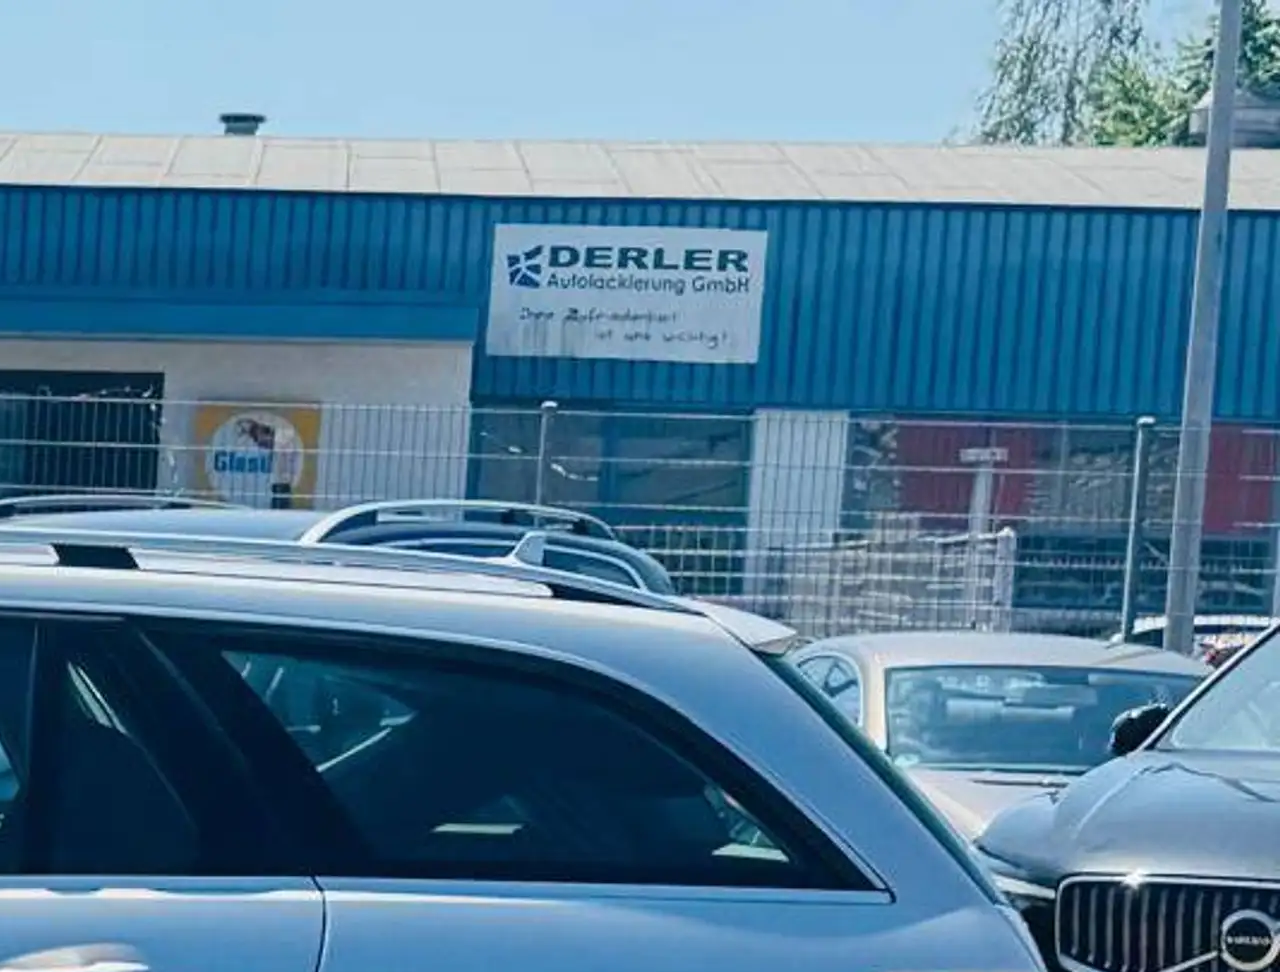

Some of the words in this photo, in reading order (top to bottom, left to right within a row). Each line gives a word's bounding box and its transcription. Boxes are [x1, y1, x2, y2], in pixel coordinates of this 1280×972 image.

[547, 244, 749, 272] DERLER
[546, 273, 686, 296] Autolackierung
[692, 275, 750, 294] GmbH
